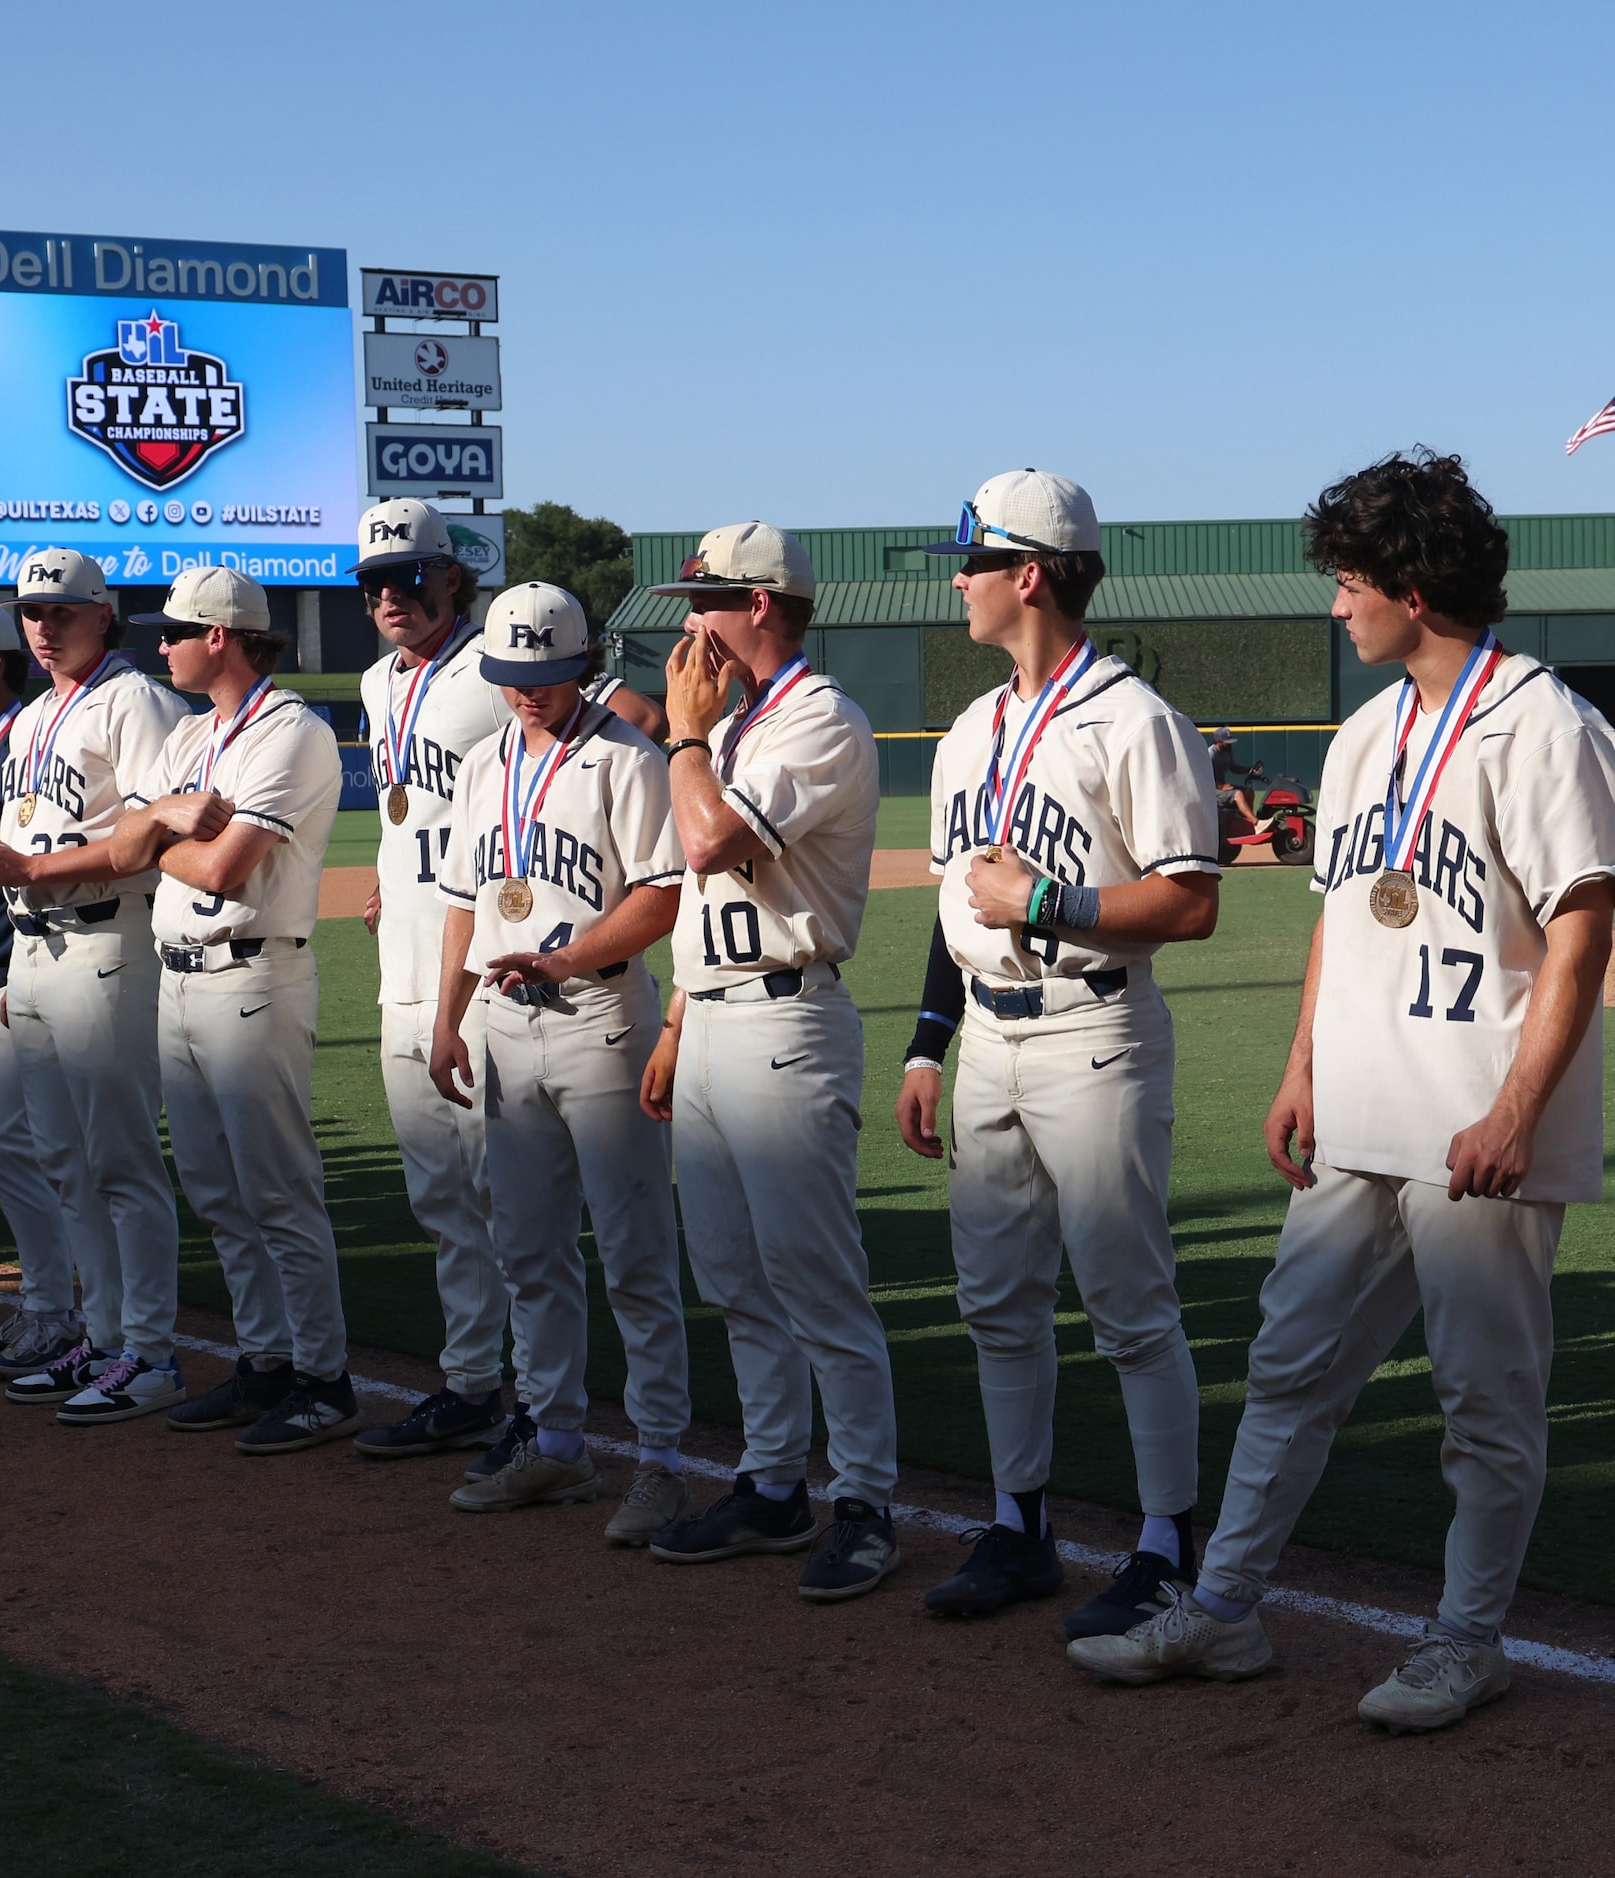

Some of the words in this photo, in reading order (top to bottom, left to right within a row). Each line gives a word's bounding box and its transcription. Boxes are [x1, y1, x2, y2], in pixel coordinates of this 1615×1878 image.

[94, 243, 319, 300] Diamond
[111, 367, 199, 385] BASEBALL
[371, 377, 422, 392] United
[427, 379, 493, 398] Heritage
[75, 385, 238, 427] STATE
[400, 394, 433, 405] Credit
[106, 426, 209, 441] CHAMPIONSHIPS
[382, 442, 487, 478] GOYA
[221, 505, 320, 524] #UILSTATE
[370, 521, 412, 544] FM
[123, 545, 151, 577] to
[162, 551, 211, 577] Dell
[213, 552, 337, 577] Diamond
[26, 564, 66, 585] FM
[508, 623, 555, 649] FM
[702, 901, 763, 964] 10
[1409, 944, 1484, 1022] 17
